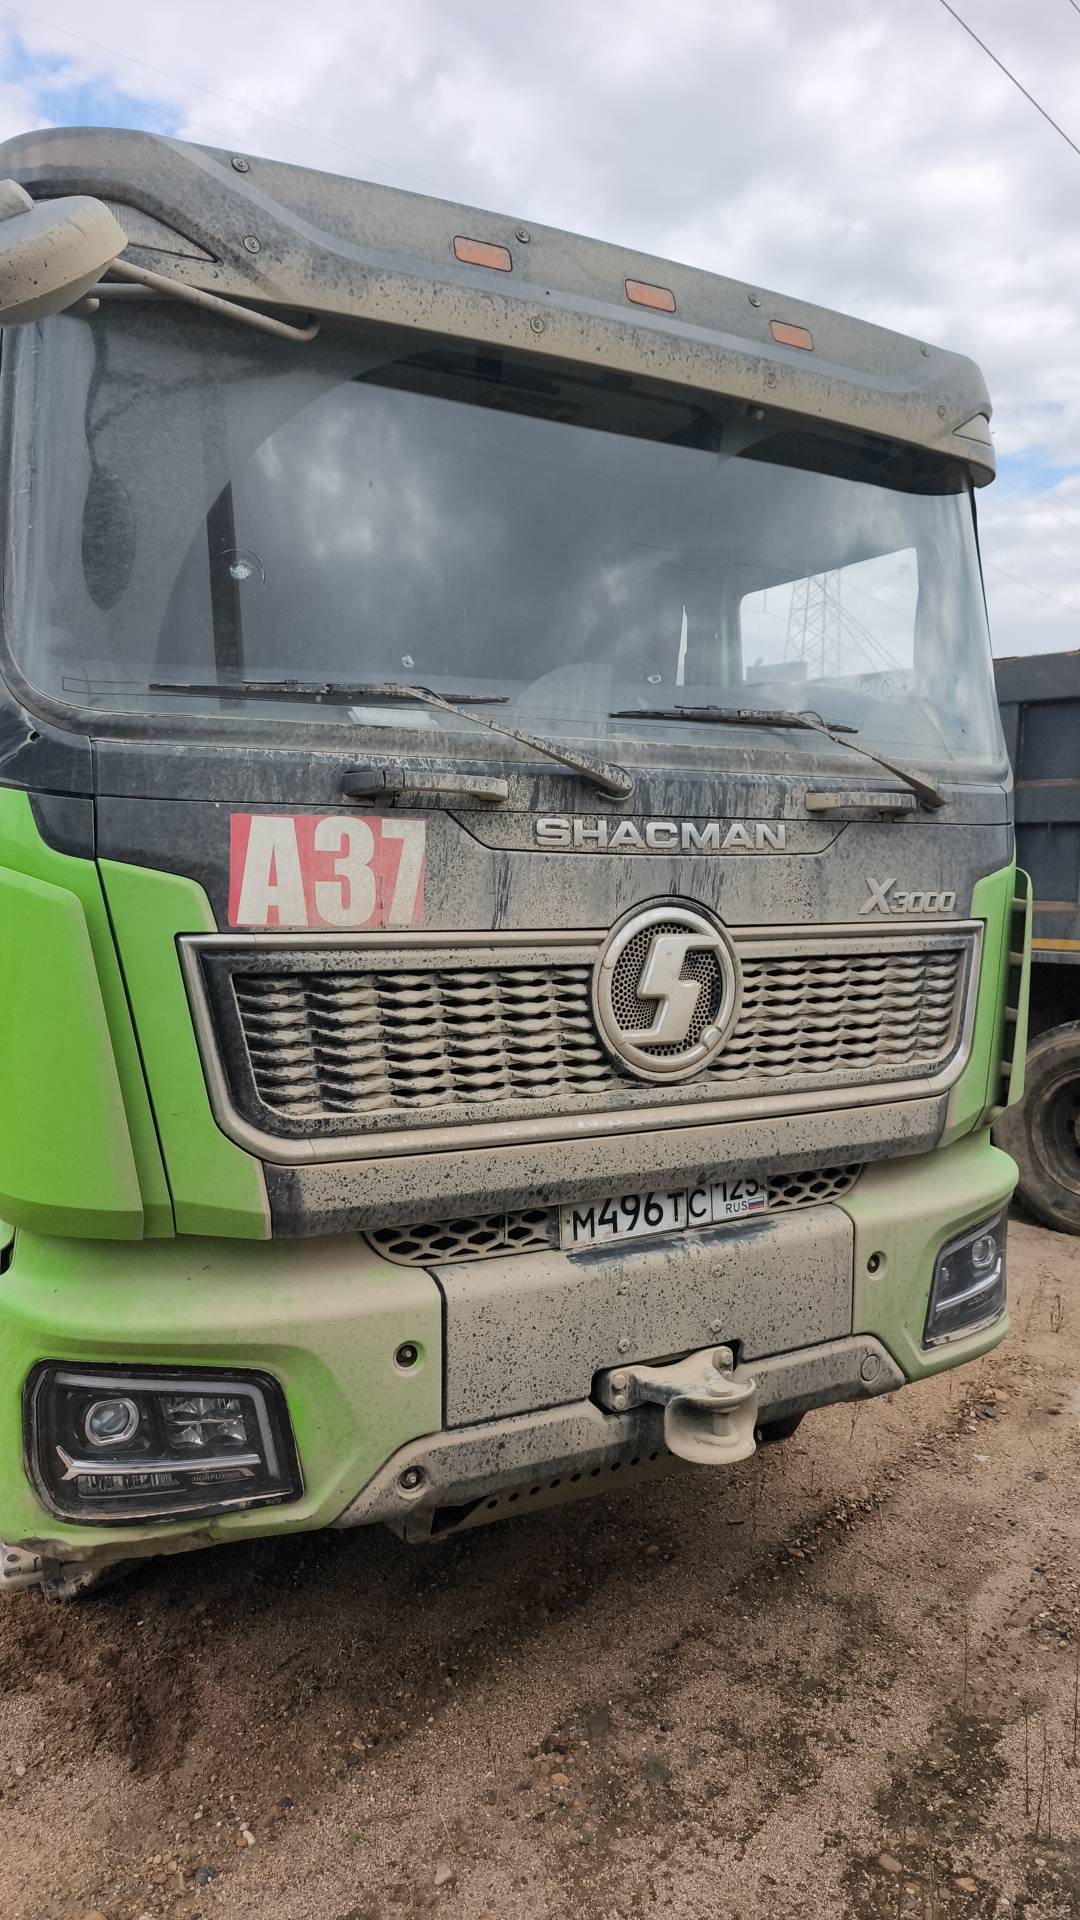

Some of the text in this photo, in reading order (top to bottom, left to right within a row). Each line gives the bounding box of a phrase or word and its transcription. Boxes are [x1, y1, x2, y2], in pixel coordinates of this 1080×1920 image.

[536, 817, 786, 850] SHACMAN
[237, 815, 426, 927] A37
[857, 877, 956, 914] X3000
[726, 1200, 748, 1214] RUS
